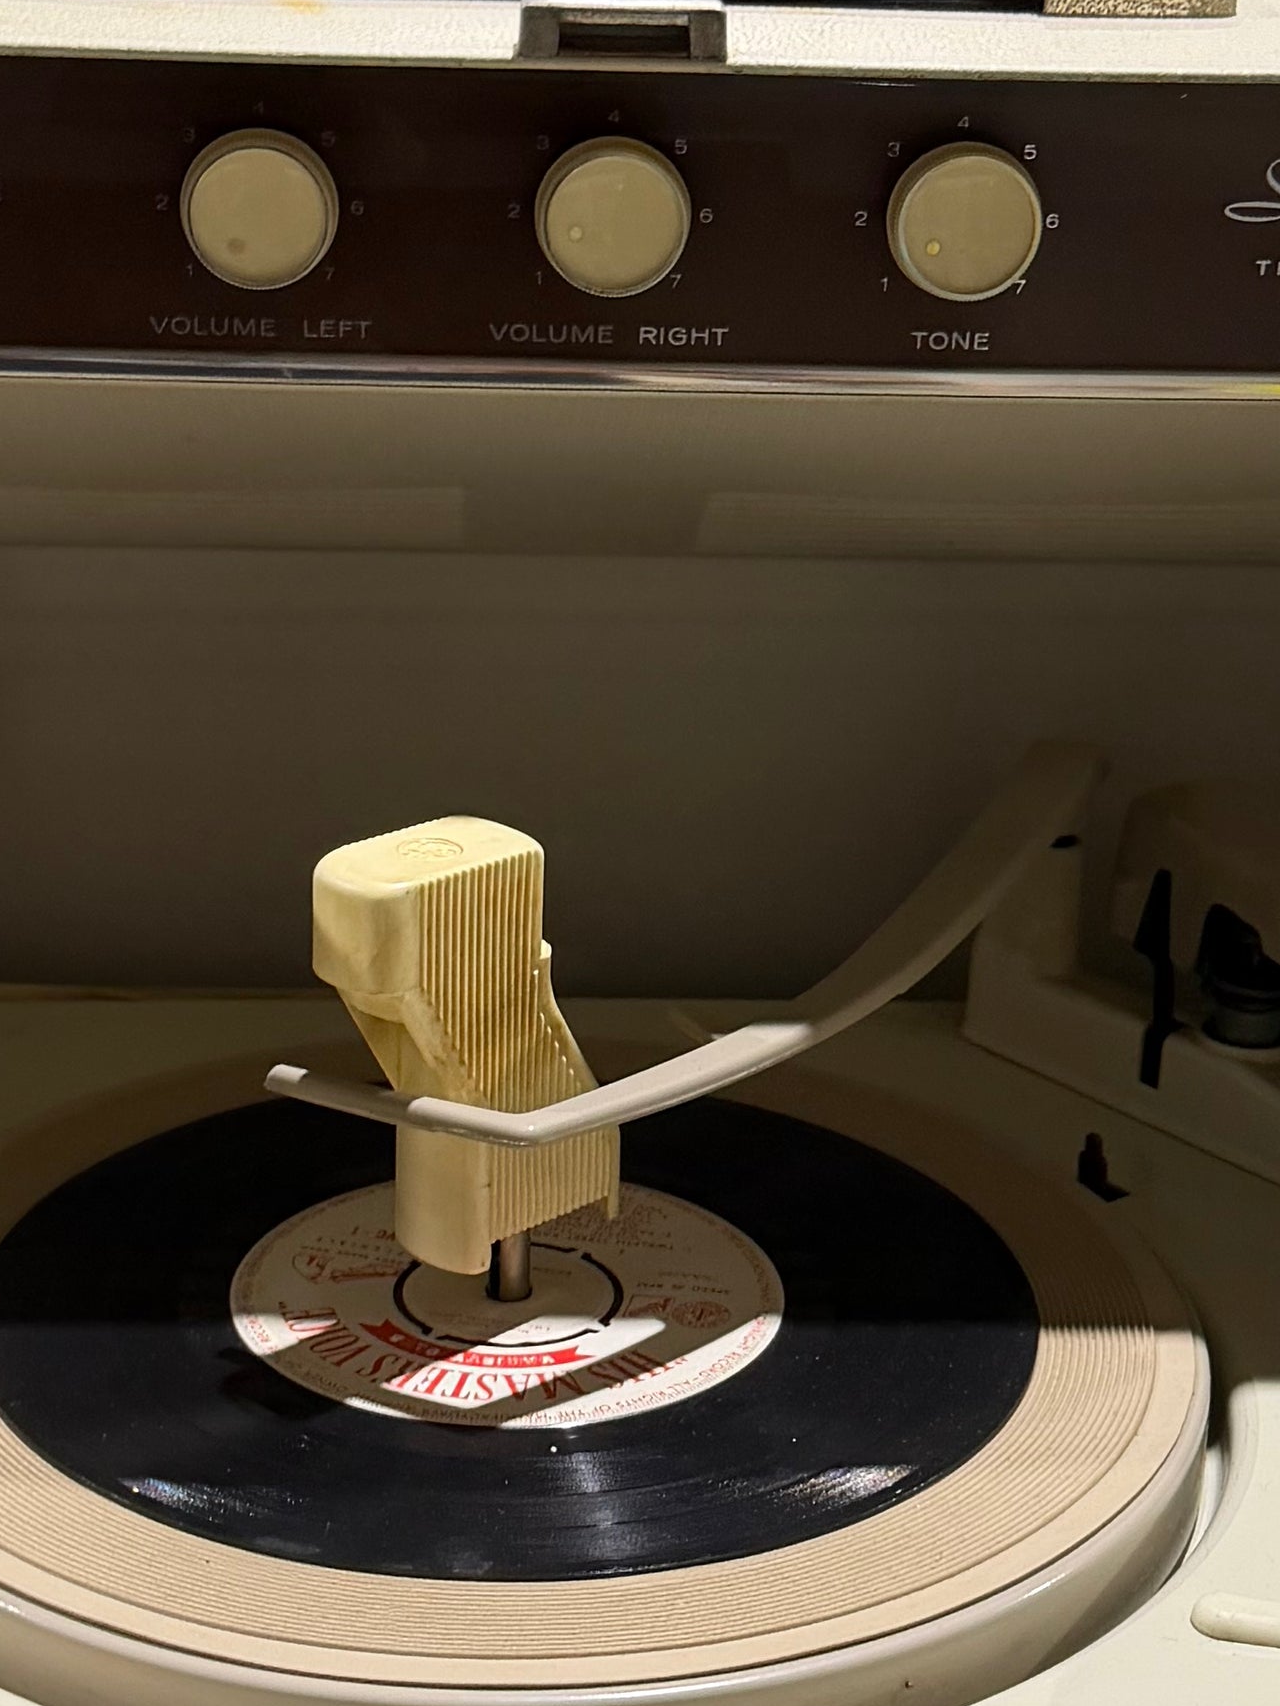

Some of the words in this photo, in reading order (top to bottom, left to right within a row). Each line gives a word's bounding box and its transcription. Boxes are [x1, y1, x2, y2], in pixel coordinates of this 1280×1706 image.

[957, 116, 969, 128] 4
[674, 139, 687, 154] 5
[887, 143, 900, 157] 3
[1023, 145, 1037, 160] 5
[156, 195, 168, 210] 2
[351, 201, 364, 215] 6
[508, 204, 520, 218] 2
[700, 209, 713, 223] 6
[854, 211, 868, 226] 2
[1046, 214, 1059, 229] 6
[150, 316, 276, 337] VOLUME
[303, 320, 372, 340] LEFT
[489, 323, 613, 344] VOLUME
[639, 327, 729, 346] RIGHT
[911, 332, 990, 352] TONE
